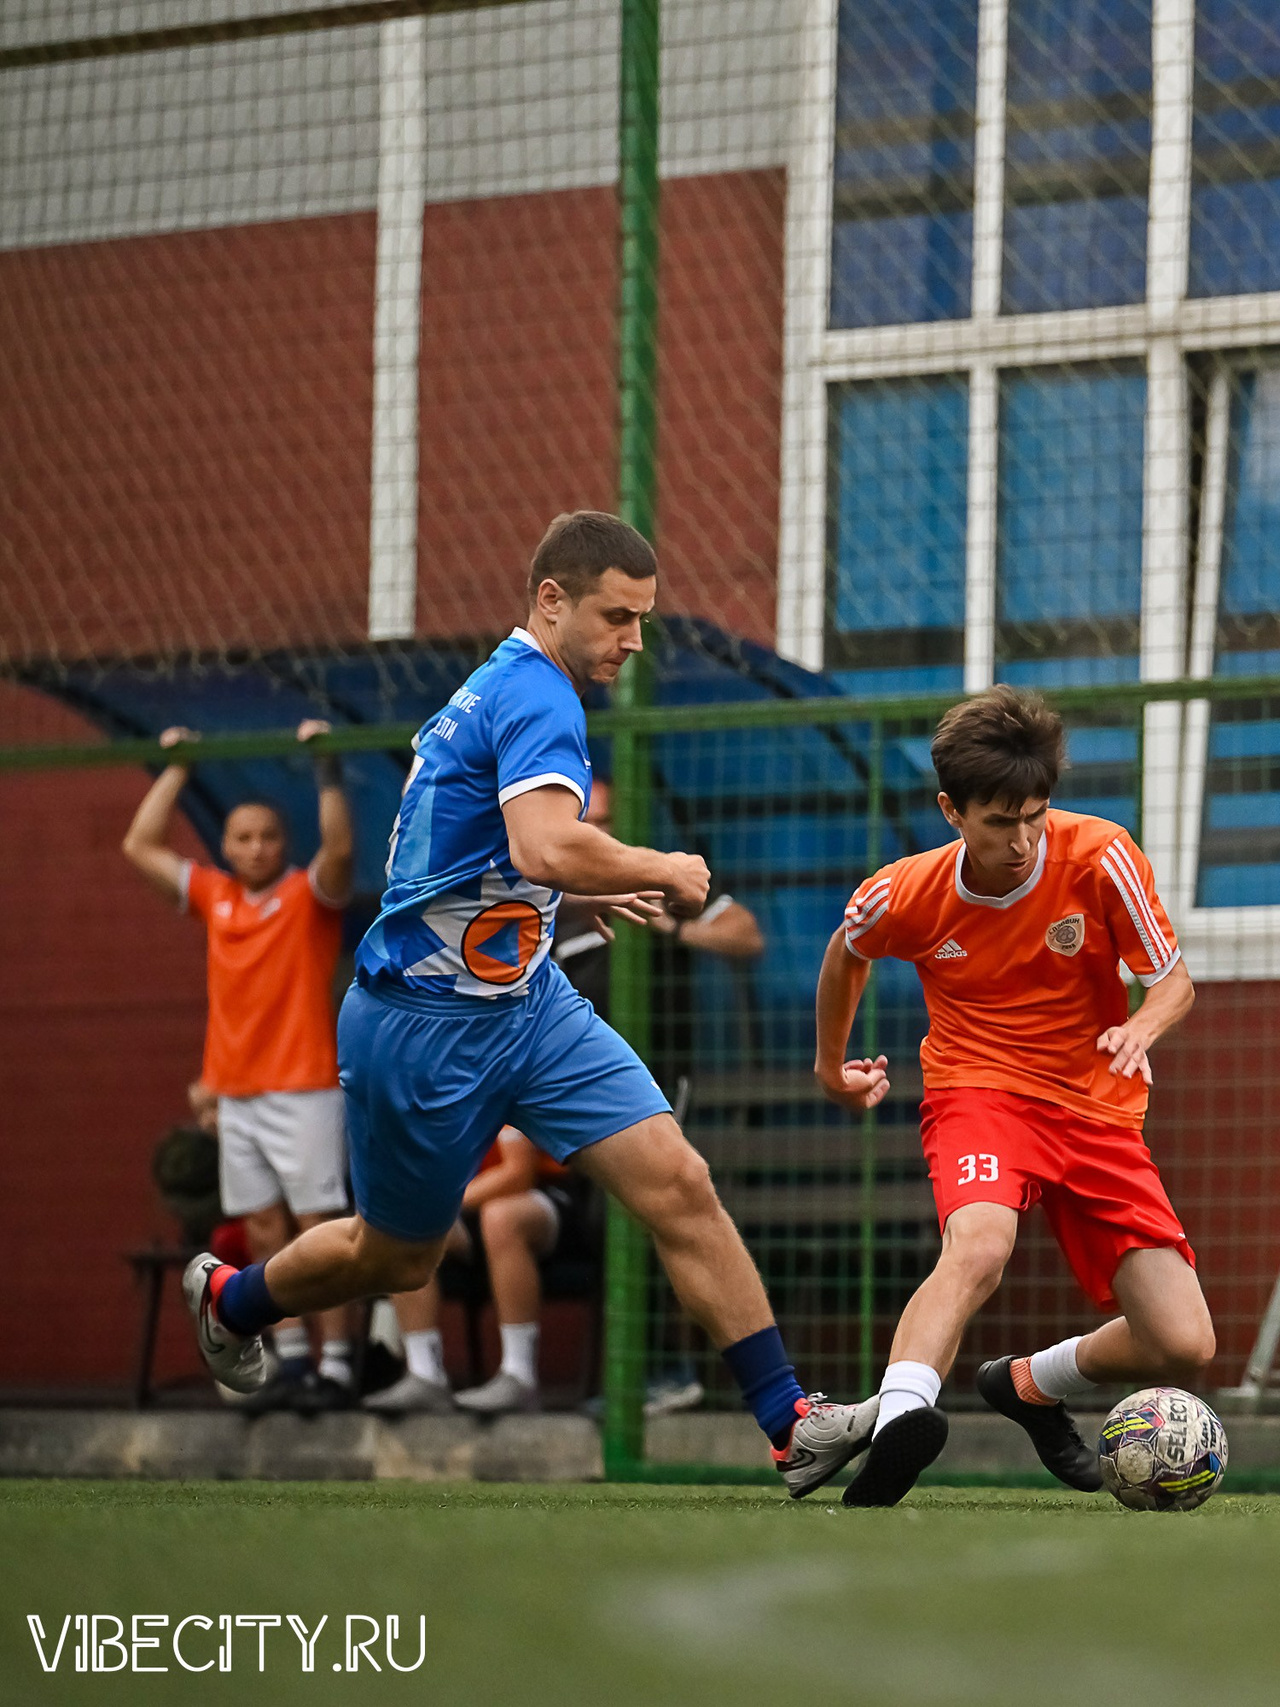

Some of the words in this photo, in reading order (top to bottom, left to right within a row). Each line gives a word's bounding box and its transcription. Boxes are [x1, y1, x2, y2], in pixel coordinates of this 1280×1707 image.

[934, 950, 968, 960] adidas
[957, 1153, 999, 1186] 33
[1166, 1396, 1188, 1463] SELECT
